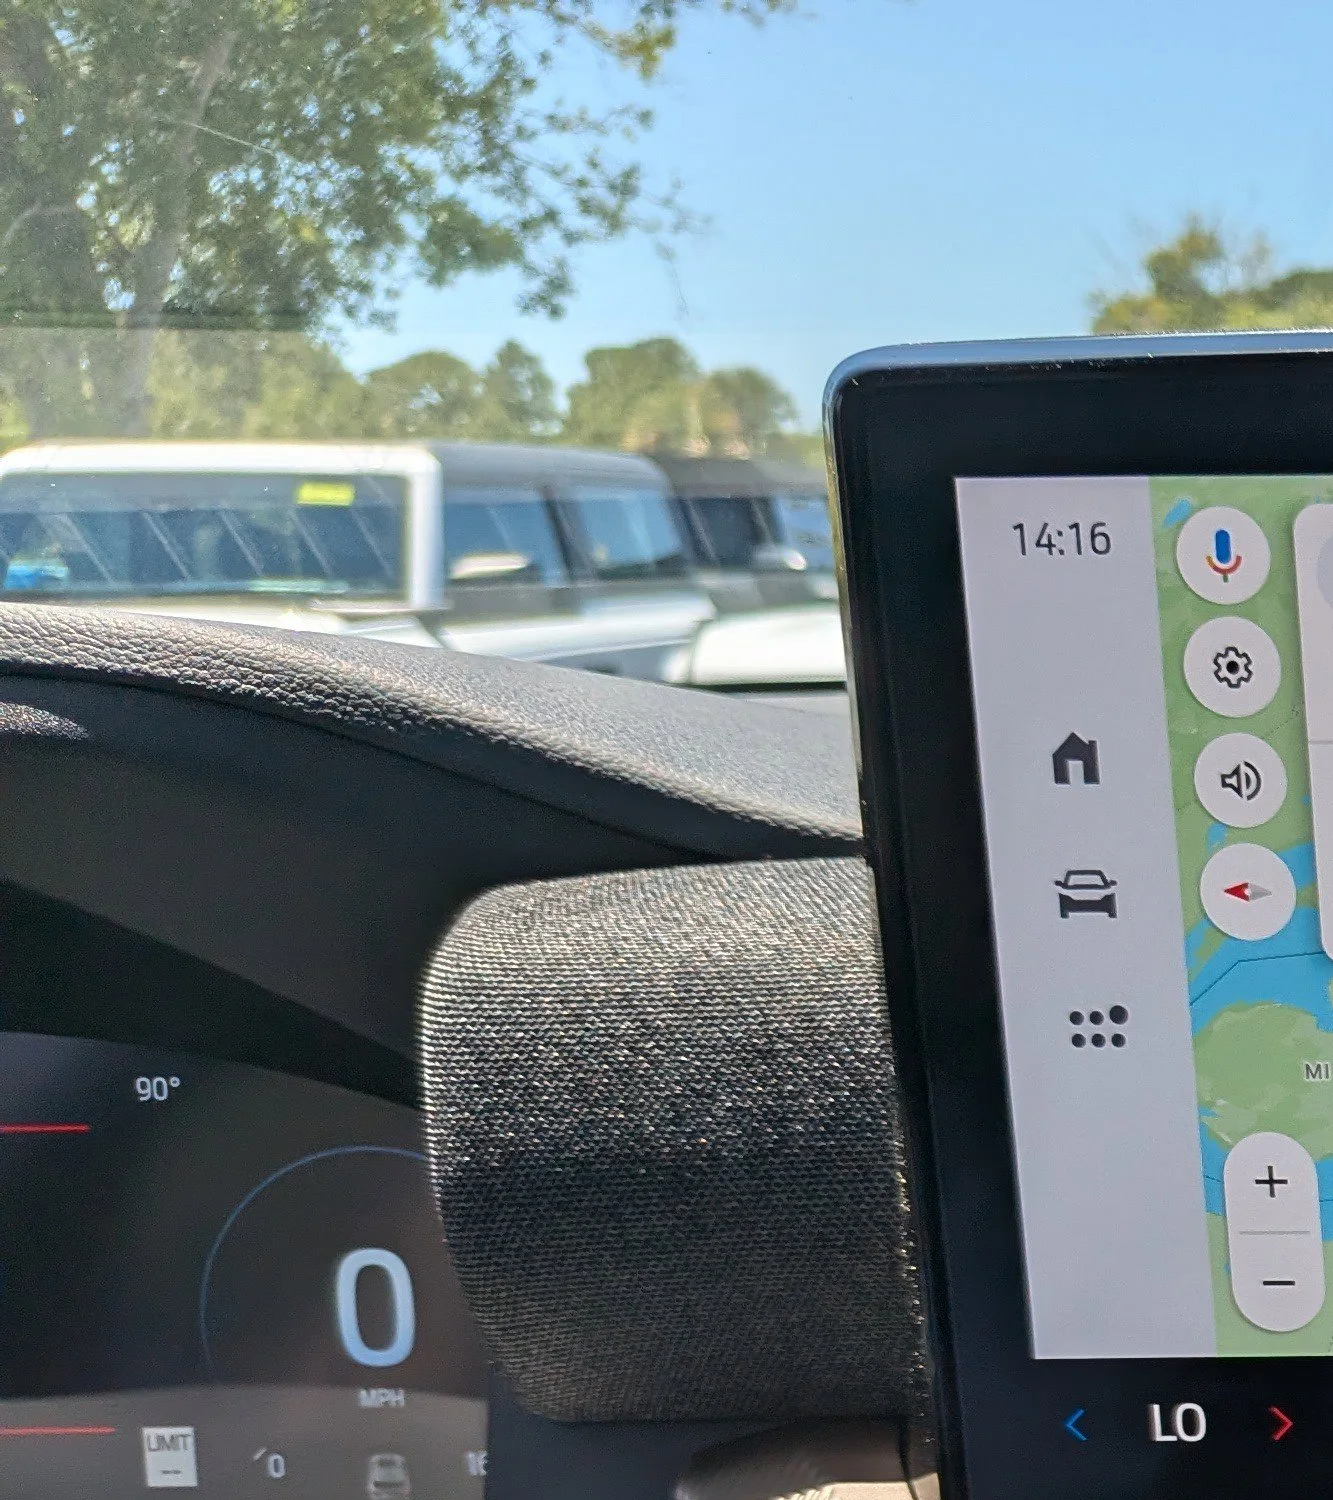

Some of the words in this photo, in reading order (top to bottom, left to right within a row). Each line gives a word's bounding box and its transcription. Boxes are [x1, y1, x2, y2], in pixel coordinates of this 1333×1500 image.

[1012, 522, 1112, 557] 14:16
[135, 1075, 181, 1102] 90°
[1304, 1062, 1331, 1082] MI
[336, 1247, 417, 1368] 0
[1148, 1402, 1207, 1442] LO
